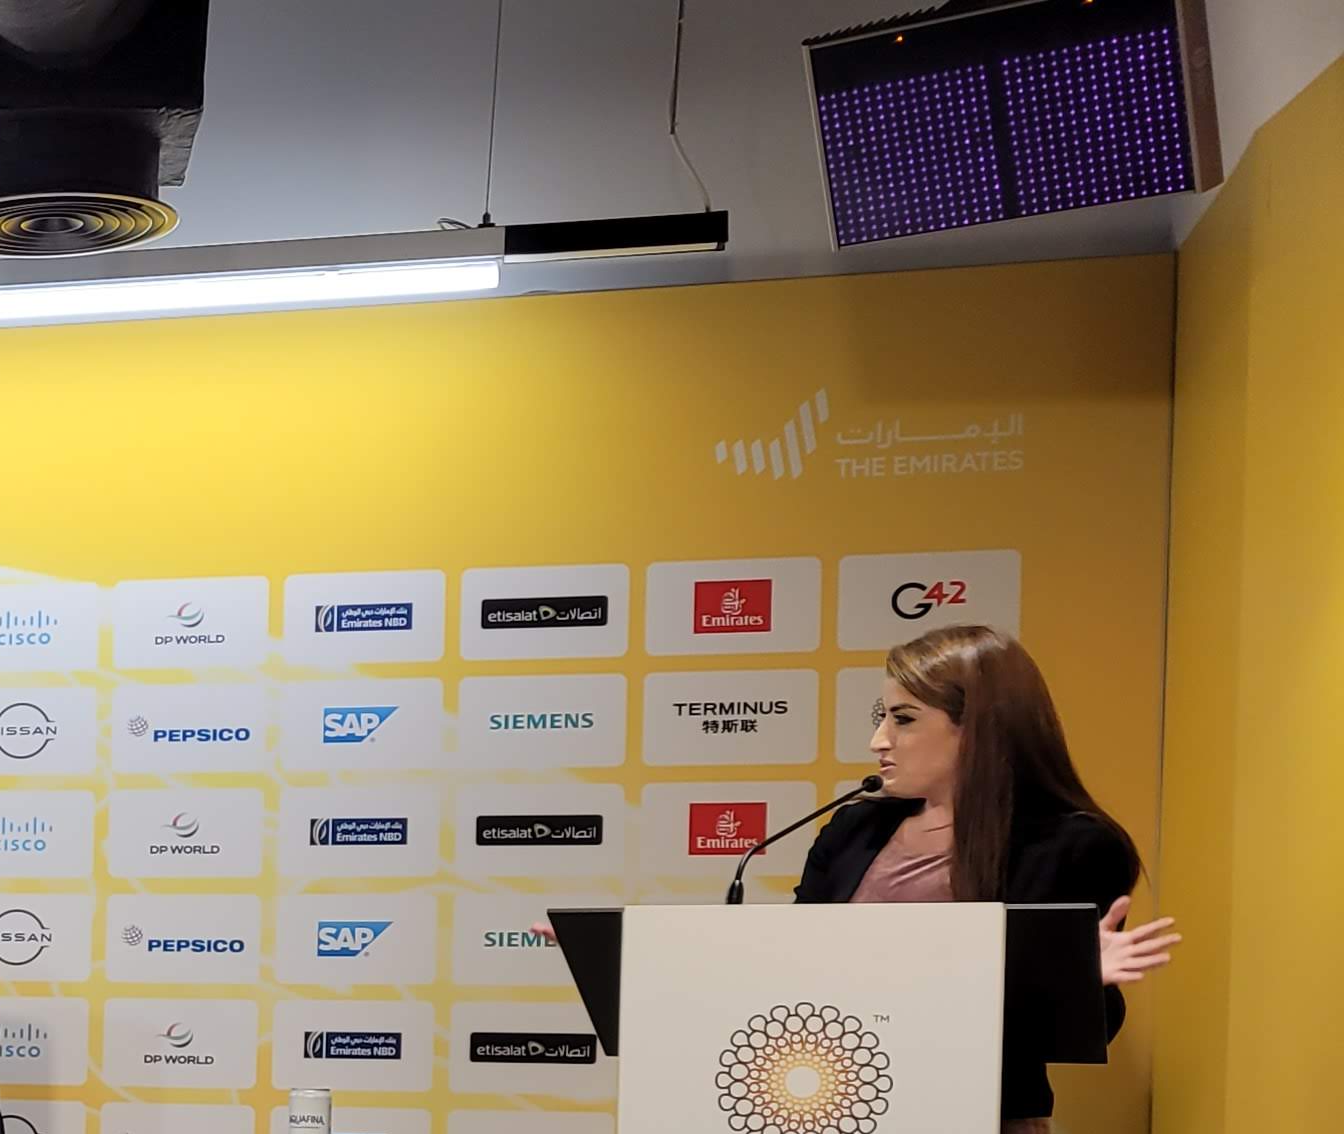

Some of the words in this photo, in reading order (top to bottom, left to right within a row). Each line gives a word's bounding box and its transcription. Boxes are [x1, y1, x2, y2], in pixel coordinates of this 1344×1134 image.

[835, 457, 884, 478] THE
[893, 450, 1023, 476] EMIRATES
[892, 582, 965, 619] G42
[488, 610, 537, 622] etisalat
[702, 613, 763, 626] Emirates
[341, 617, 381, 630] Emirates
[384, 616, 407, 627] NBD
[155, 636, 173, 645] DP
[176, 635, 224, 644] WORLD
[673, 701, 787, 716] TERMINUS
[325, 713, 379, 737] SAP
[490, 713, 593, 729] SIEMENS
[702, 720, 757, 733] 特斯联
[154, 728, 250, 742] PEPSICO
[336, 831, 375, 843] Emirates
[378, 831, 402, 842] NBD
[483, 828, 532, 838] etisalat
[150, 846, 168, 854] DP
[170, 846, 220, 854] WORLD
[319, 927, 373, 951] SAP
[148, 940, 244, 952] PEPSICO
[330, 1046, 370, 1057] Emirates
[372, 1046, 396, 1057] NBD
[477, 1045, 526, 1056] etisalat
[144, 1055, 162, 1063] DP
[164, 1056, 214, 1064] WORLD
